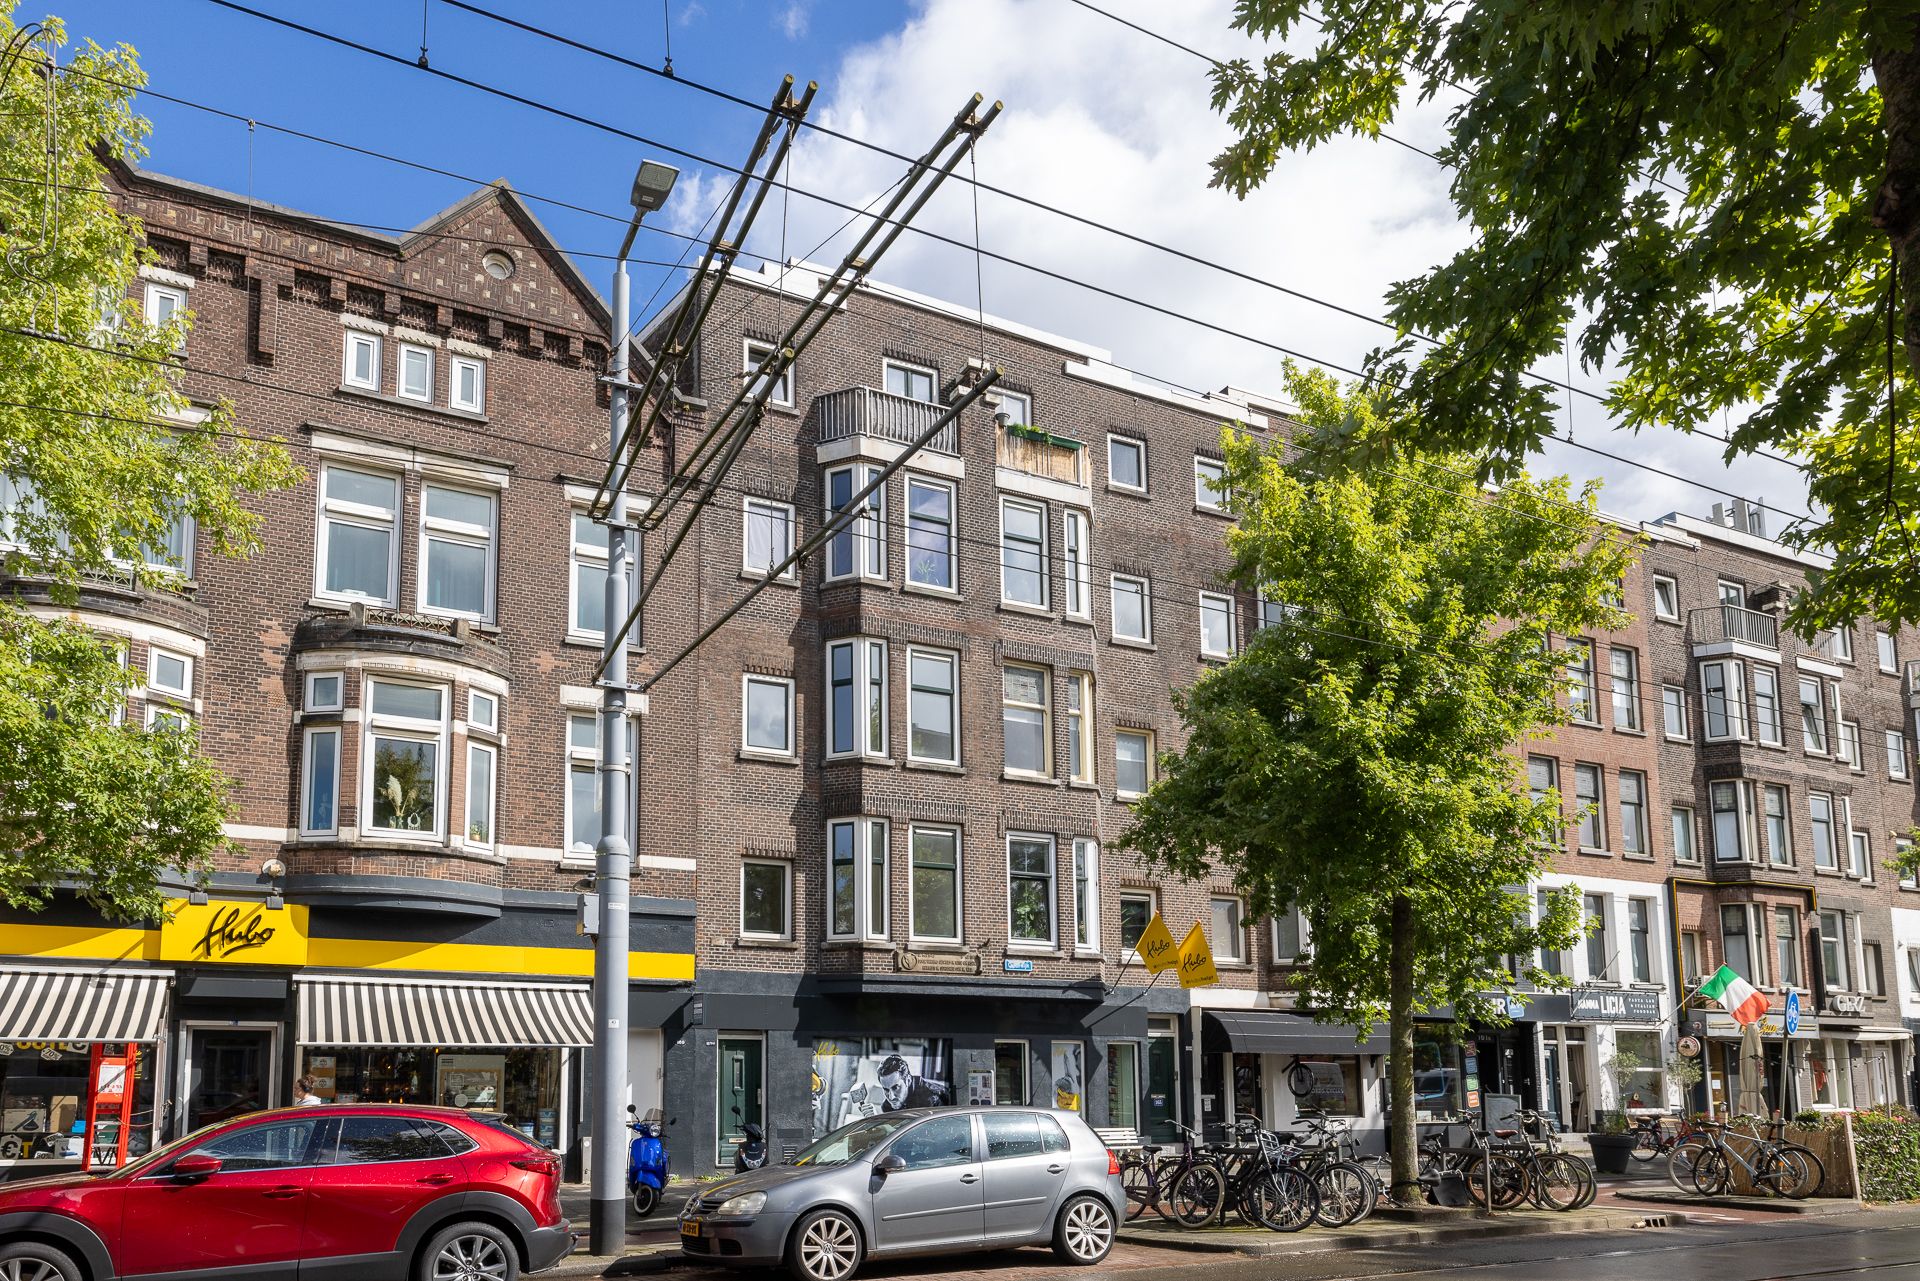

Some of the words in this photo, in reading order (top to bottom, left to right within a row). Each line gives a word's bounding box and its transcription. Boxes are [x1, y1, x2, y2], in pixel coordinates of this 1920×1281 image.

[191, 906, 276, 957] Hubo
[1147, 939, 1170, 958] Hubo
[1182, 953, 1207, 973] Hubo
[1600, 995, 1627, 1015] LICIA
